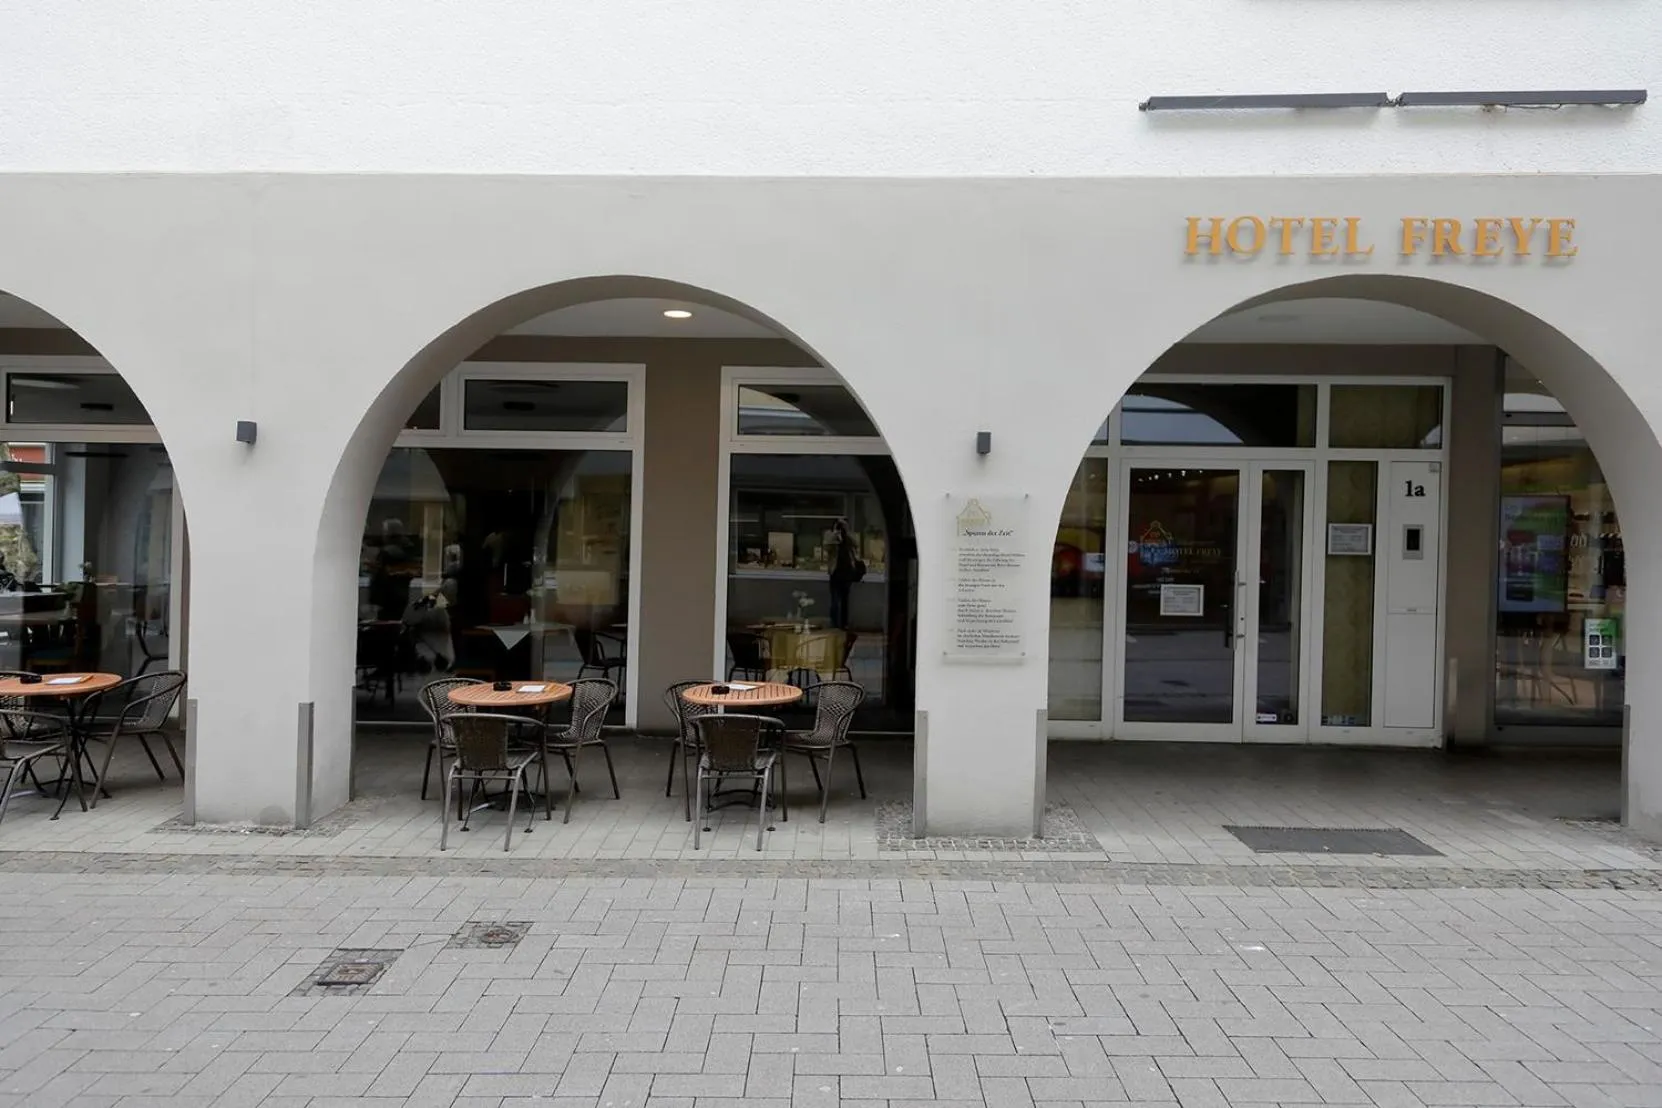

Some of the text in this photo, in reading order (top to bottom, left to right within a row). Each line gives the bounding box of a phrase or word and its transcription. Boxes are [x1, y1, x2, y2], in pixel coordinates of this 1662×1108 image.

[1184, 216, 1578, 257] HOTEL FREYE
[1405, 480, 1426, 497] 1a
